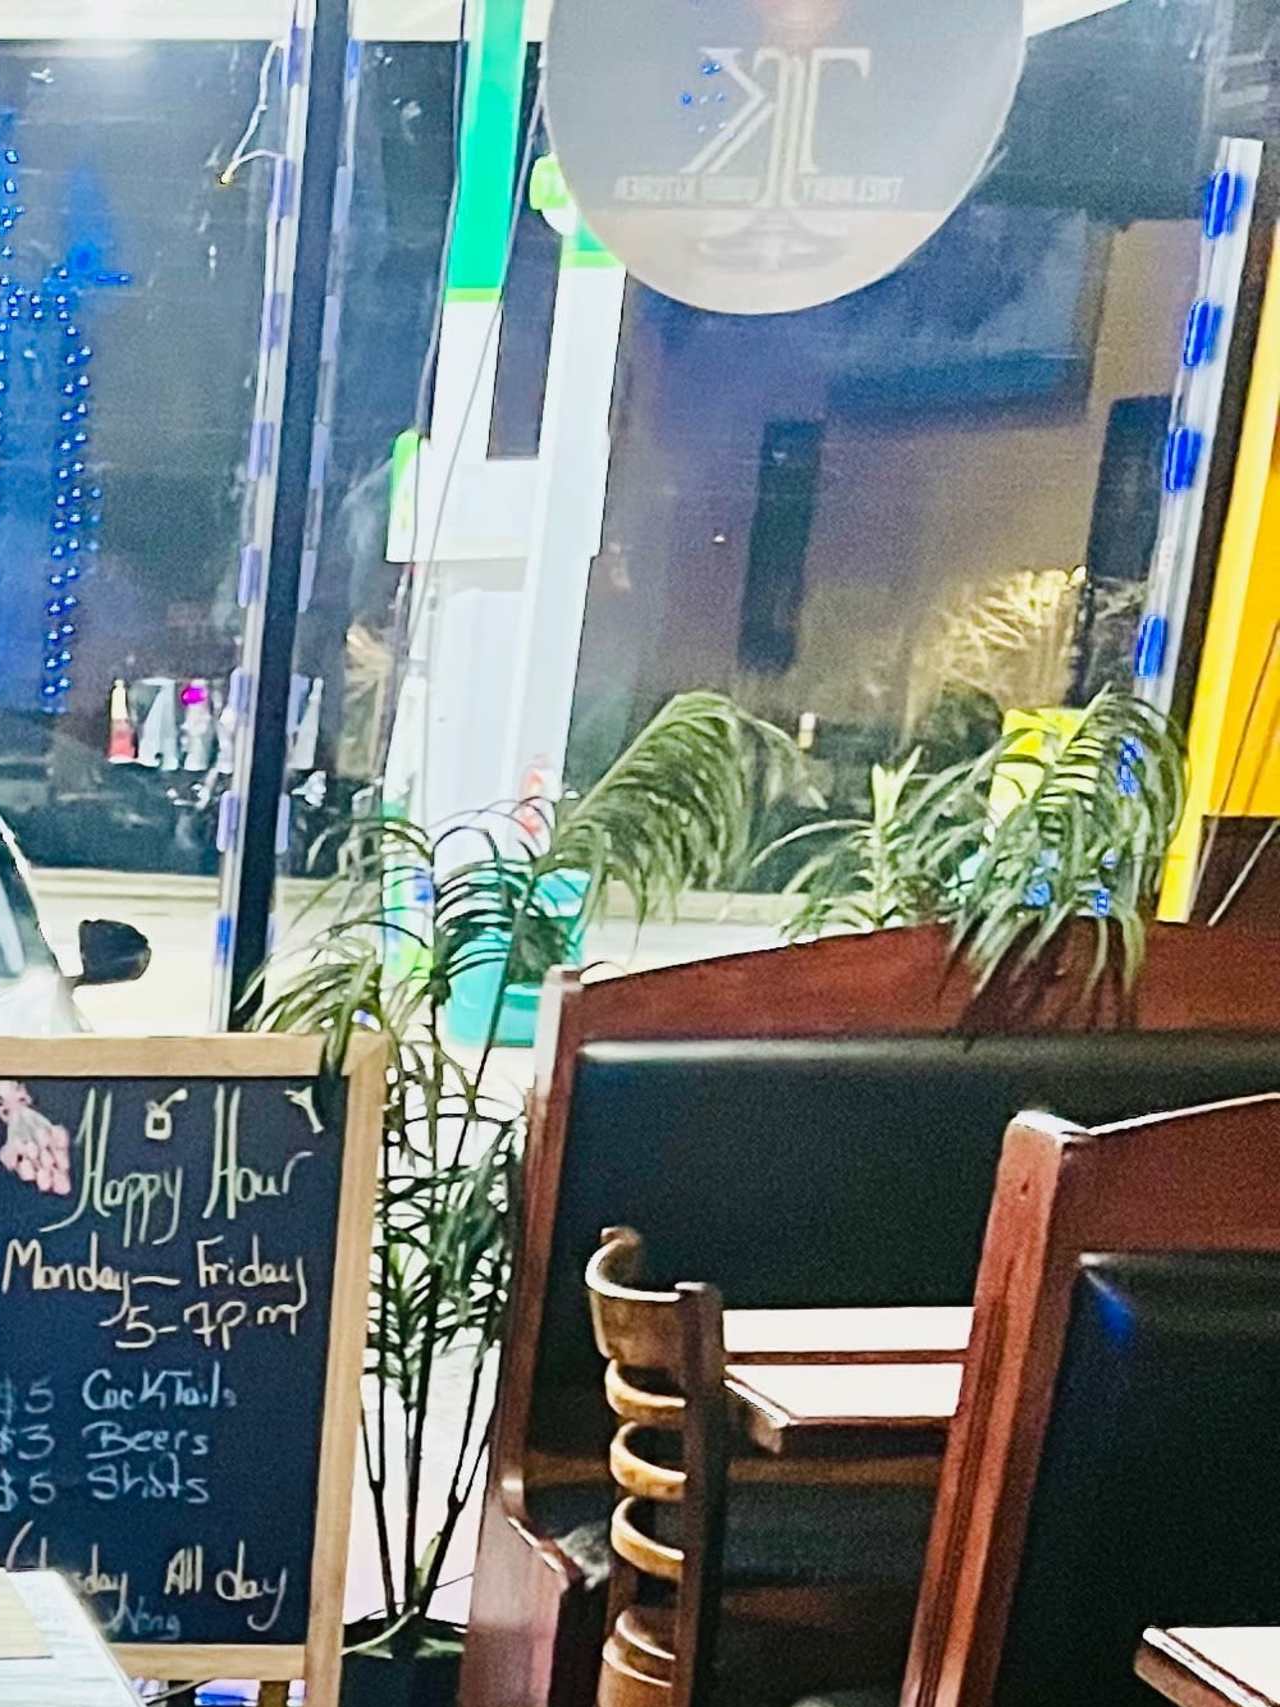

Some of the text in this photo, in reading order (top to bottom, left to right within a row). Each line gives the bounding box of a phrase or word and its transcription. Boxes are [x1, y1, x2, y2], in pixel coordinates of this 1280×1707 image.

[39, 1083, 314, 1248] Happy Hour
[196, 1232, 308, 1312] Friday
[81, 1420, 210, 1460] Beers
[86, 1452, 210, 1504] Shots
[164, 1543, 203, 1595] All
[215, 1539, 287, 1632] day
